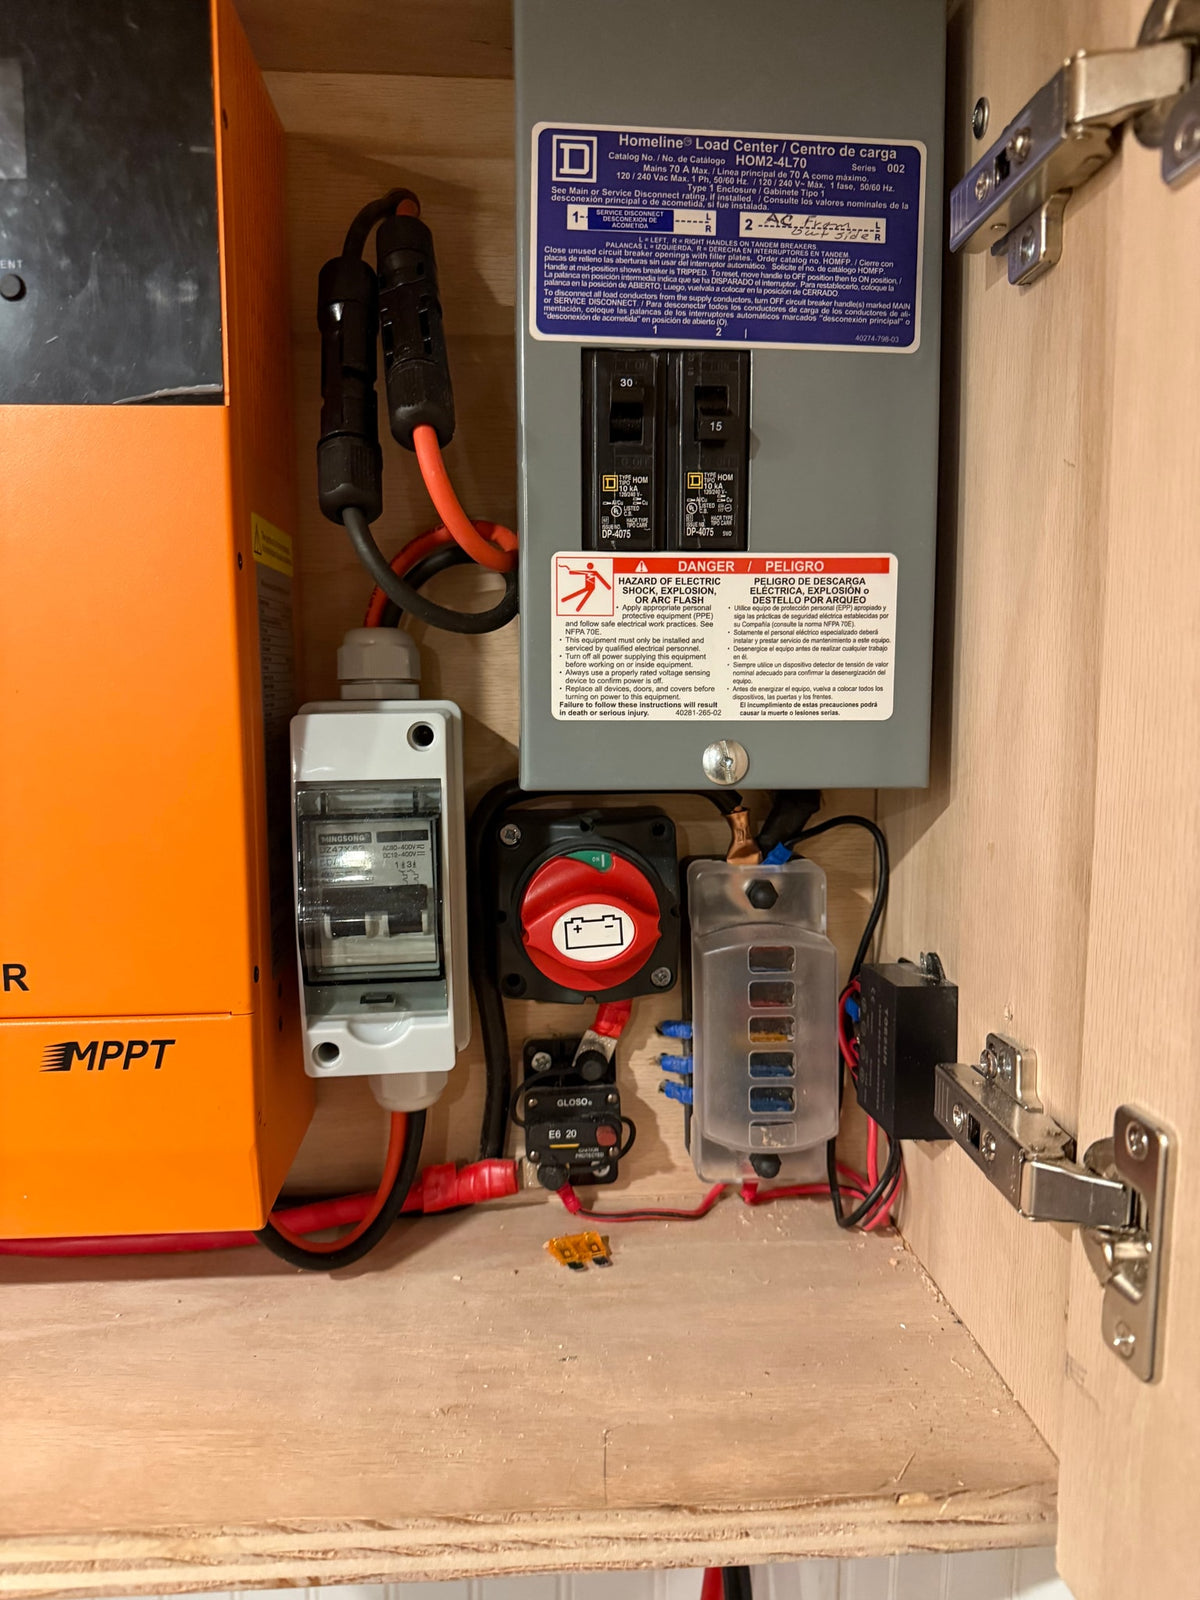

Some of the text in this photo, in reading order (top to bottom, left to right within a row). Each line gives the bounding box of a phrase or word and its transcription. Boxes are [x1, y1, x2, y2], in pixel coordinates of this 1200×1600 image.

[696, 138, 728, 150] Load
[734, 141, 778, 153] Center
[790, 143, 835, 156] Centro
[839, 145, 855, 156] de
[860, 148, 896, 160] carga
[608, 152, 639, 162] Catalog
[690, 155, 725, 164] Catálogo
[736, 155, 807, 168] HOM2-4L70
[852, 164, 876, 172] Series
[887, 164, 905, 173] 002
[717, 167, 738, 176] Línea
[741, 170, 775, 178] principal
[836, 174, 869, 182] máximo.
[688, 184, 706, 193] Type
[717, 185, 756, 194] Enclosure
[764, 187, 798, 196] Gabinete
[801, 189, 818, 198] Tipo
[573, 211, 579, 223] 1
[764, 213, 793, 225] AC
[745, 219, 753, 230] 2
[652, 326, 722, 336] 1 2
[620, 378, 633, 387] 30
[710, 421, 723, 431] 15
[602, 530, 631, 538] DP-4075
[687, 528, 714, 536] DP-4075
[678, 560, 824, 571] DANGER / PELIGRO
[750, 586, 804, 594] ELÉCTRICA,
[3, 964, 29, 991] R
[40, 1039, 176, 1072] MPPT
[549, 1130, 577, 1139] E6 20
